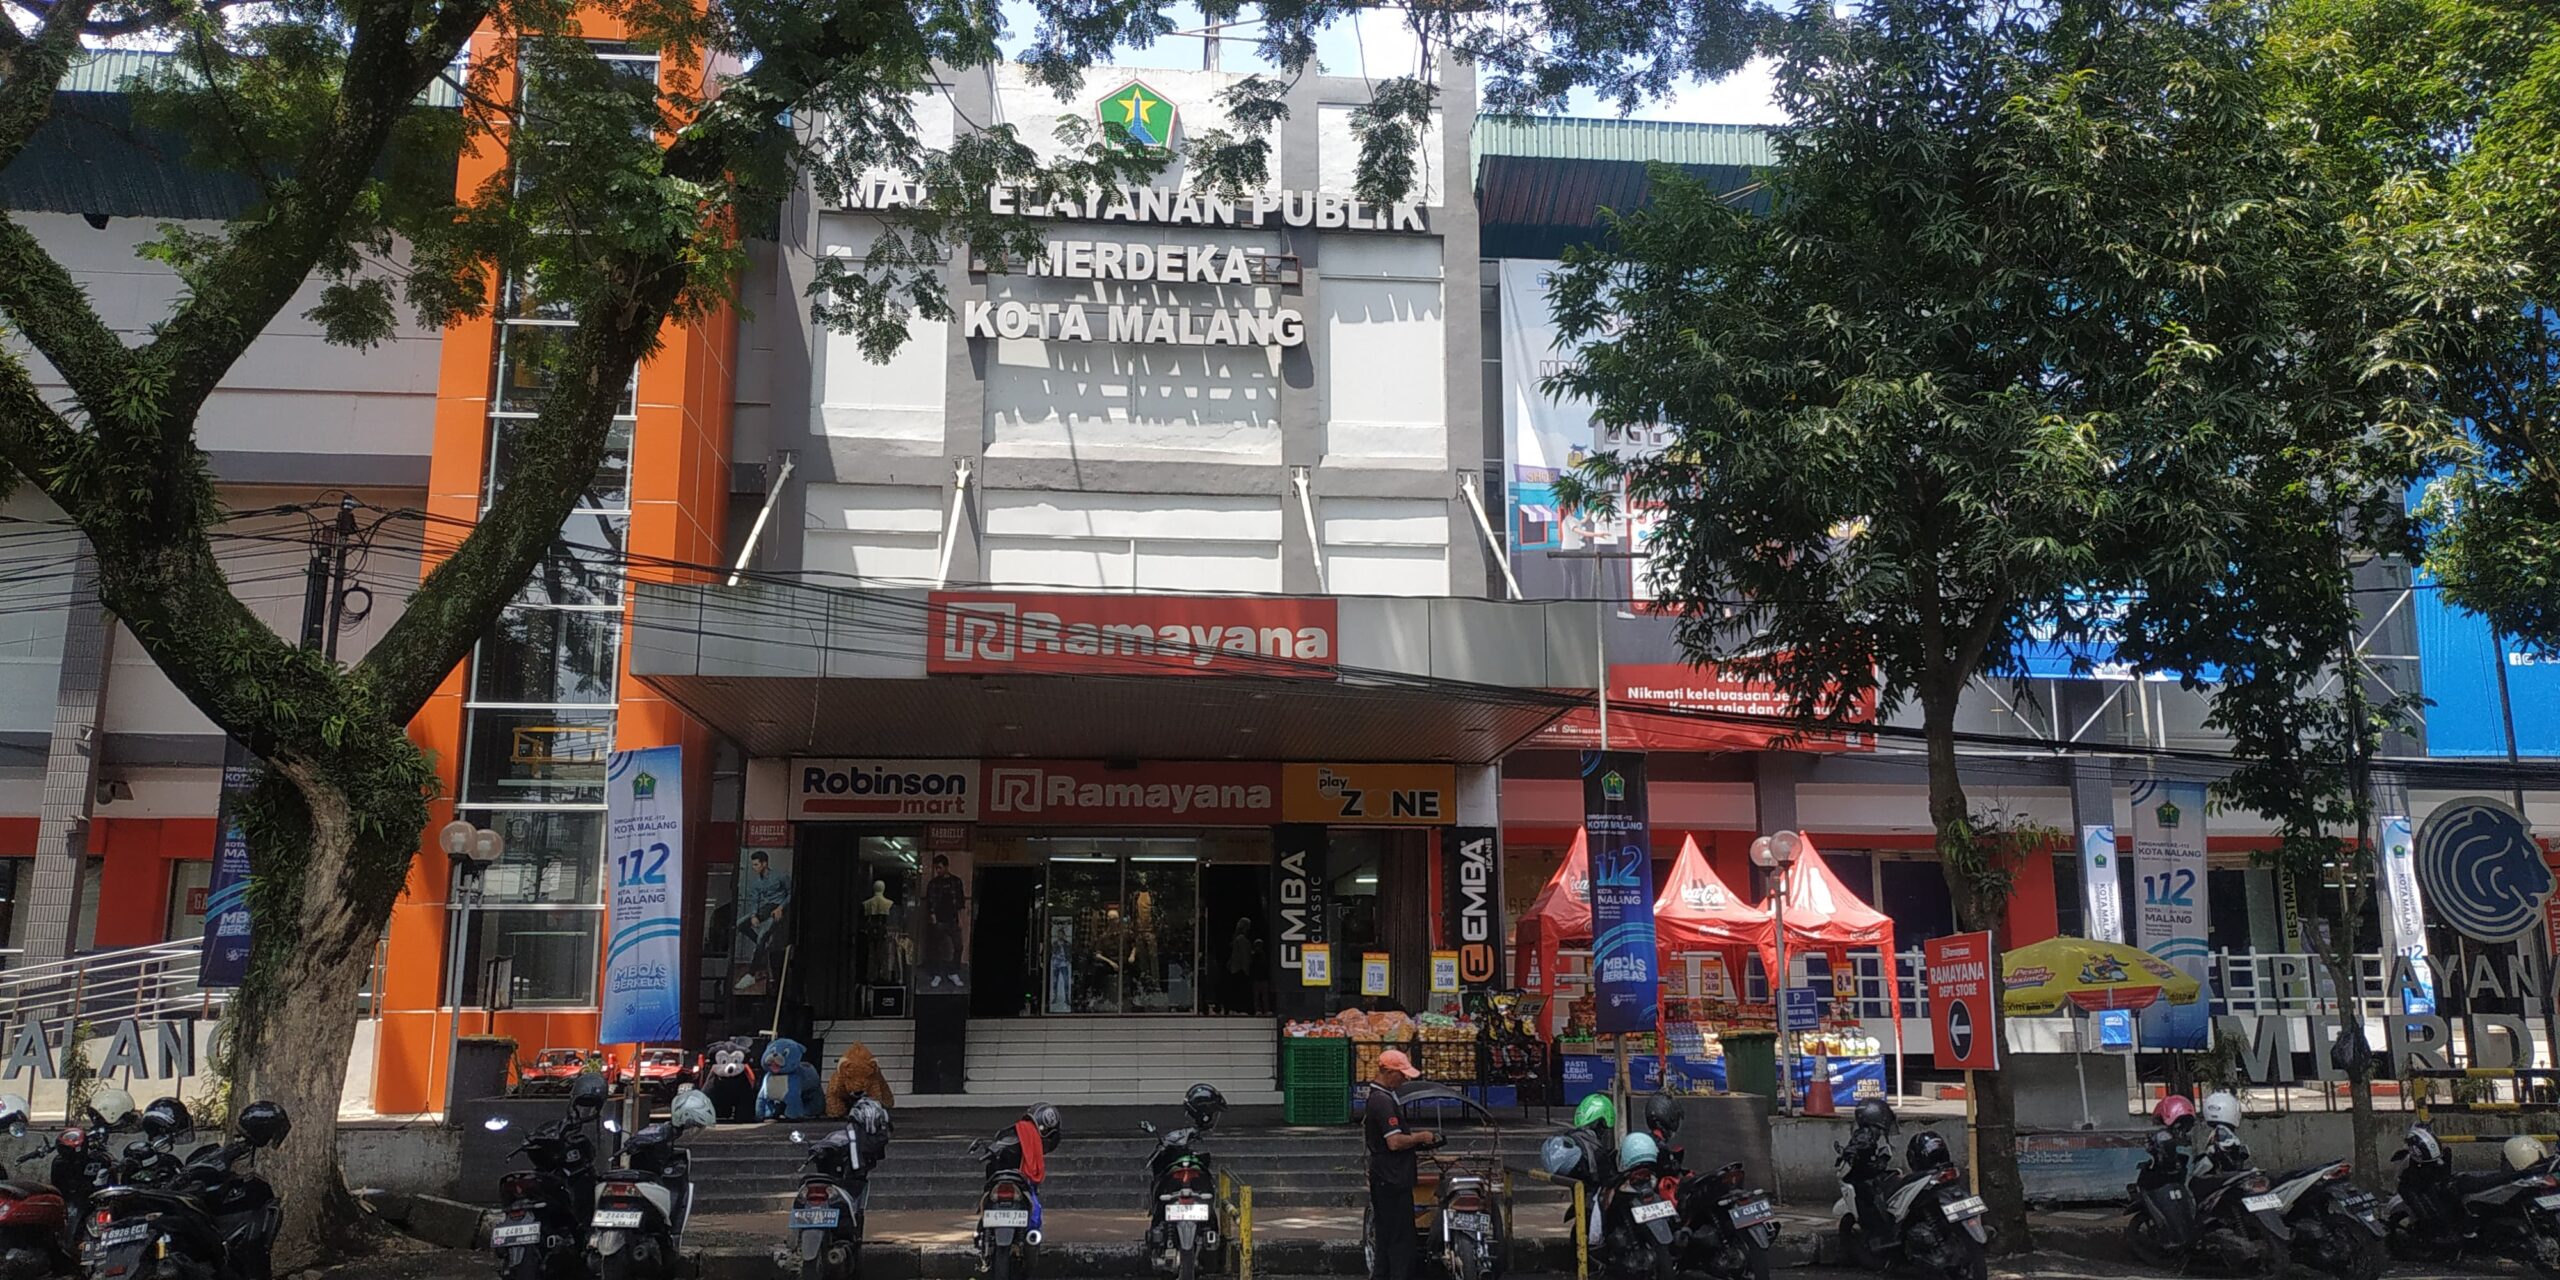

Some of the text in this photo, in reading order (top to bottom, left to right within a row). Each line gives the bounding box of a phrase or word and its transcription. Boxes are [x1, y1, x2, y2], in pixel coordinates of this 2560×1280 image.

[1252, 192, 1425, 232] PUBLIK
[1026, 240, 1251, 285] MERDEKA
[965, 300, 1305, 347] KOTA MALANG
[1022, 612, 1329, 666] Ramayana
[1628, 687, 1683, 700] Nikmati
[1686, 687, 1770, 701] keleluasaan
[803, 766, 966, 795] Robinson
[1047, 774, 1271, 814] Ramayana
[1319, 776, 1348, 790] play
[903, 797, 965, 814] mart
[614, 820, 677, 834] KOTA MALANG
[1587, 820, 1610, 830] KOTA
[617, 842, 671, 888] 112
[1484, 837, 1494, 873] JEANS
[1595, 845, 1643, 887] 112
[2138, 847, 2202, 858] KOTA MALANG
[1460, 837, 1488, 941] EMBA
[2143, 868, 2196, 907] 112
[1281, 850, 1307, 969] EMBA
[1310, 876, 1322, 944] CLASSIC
[2145, 913, 2193, 924] MALANG
[1930, 961, 1985, 985] RAMAYANA
[2015, 967, 2046, 977] Pesan
[1793, 992, 1801, 1005] P
[1956, 982, 1977, 997] STORE
[101, 1231, 107, 1241] N
